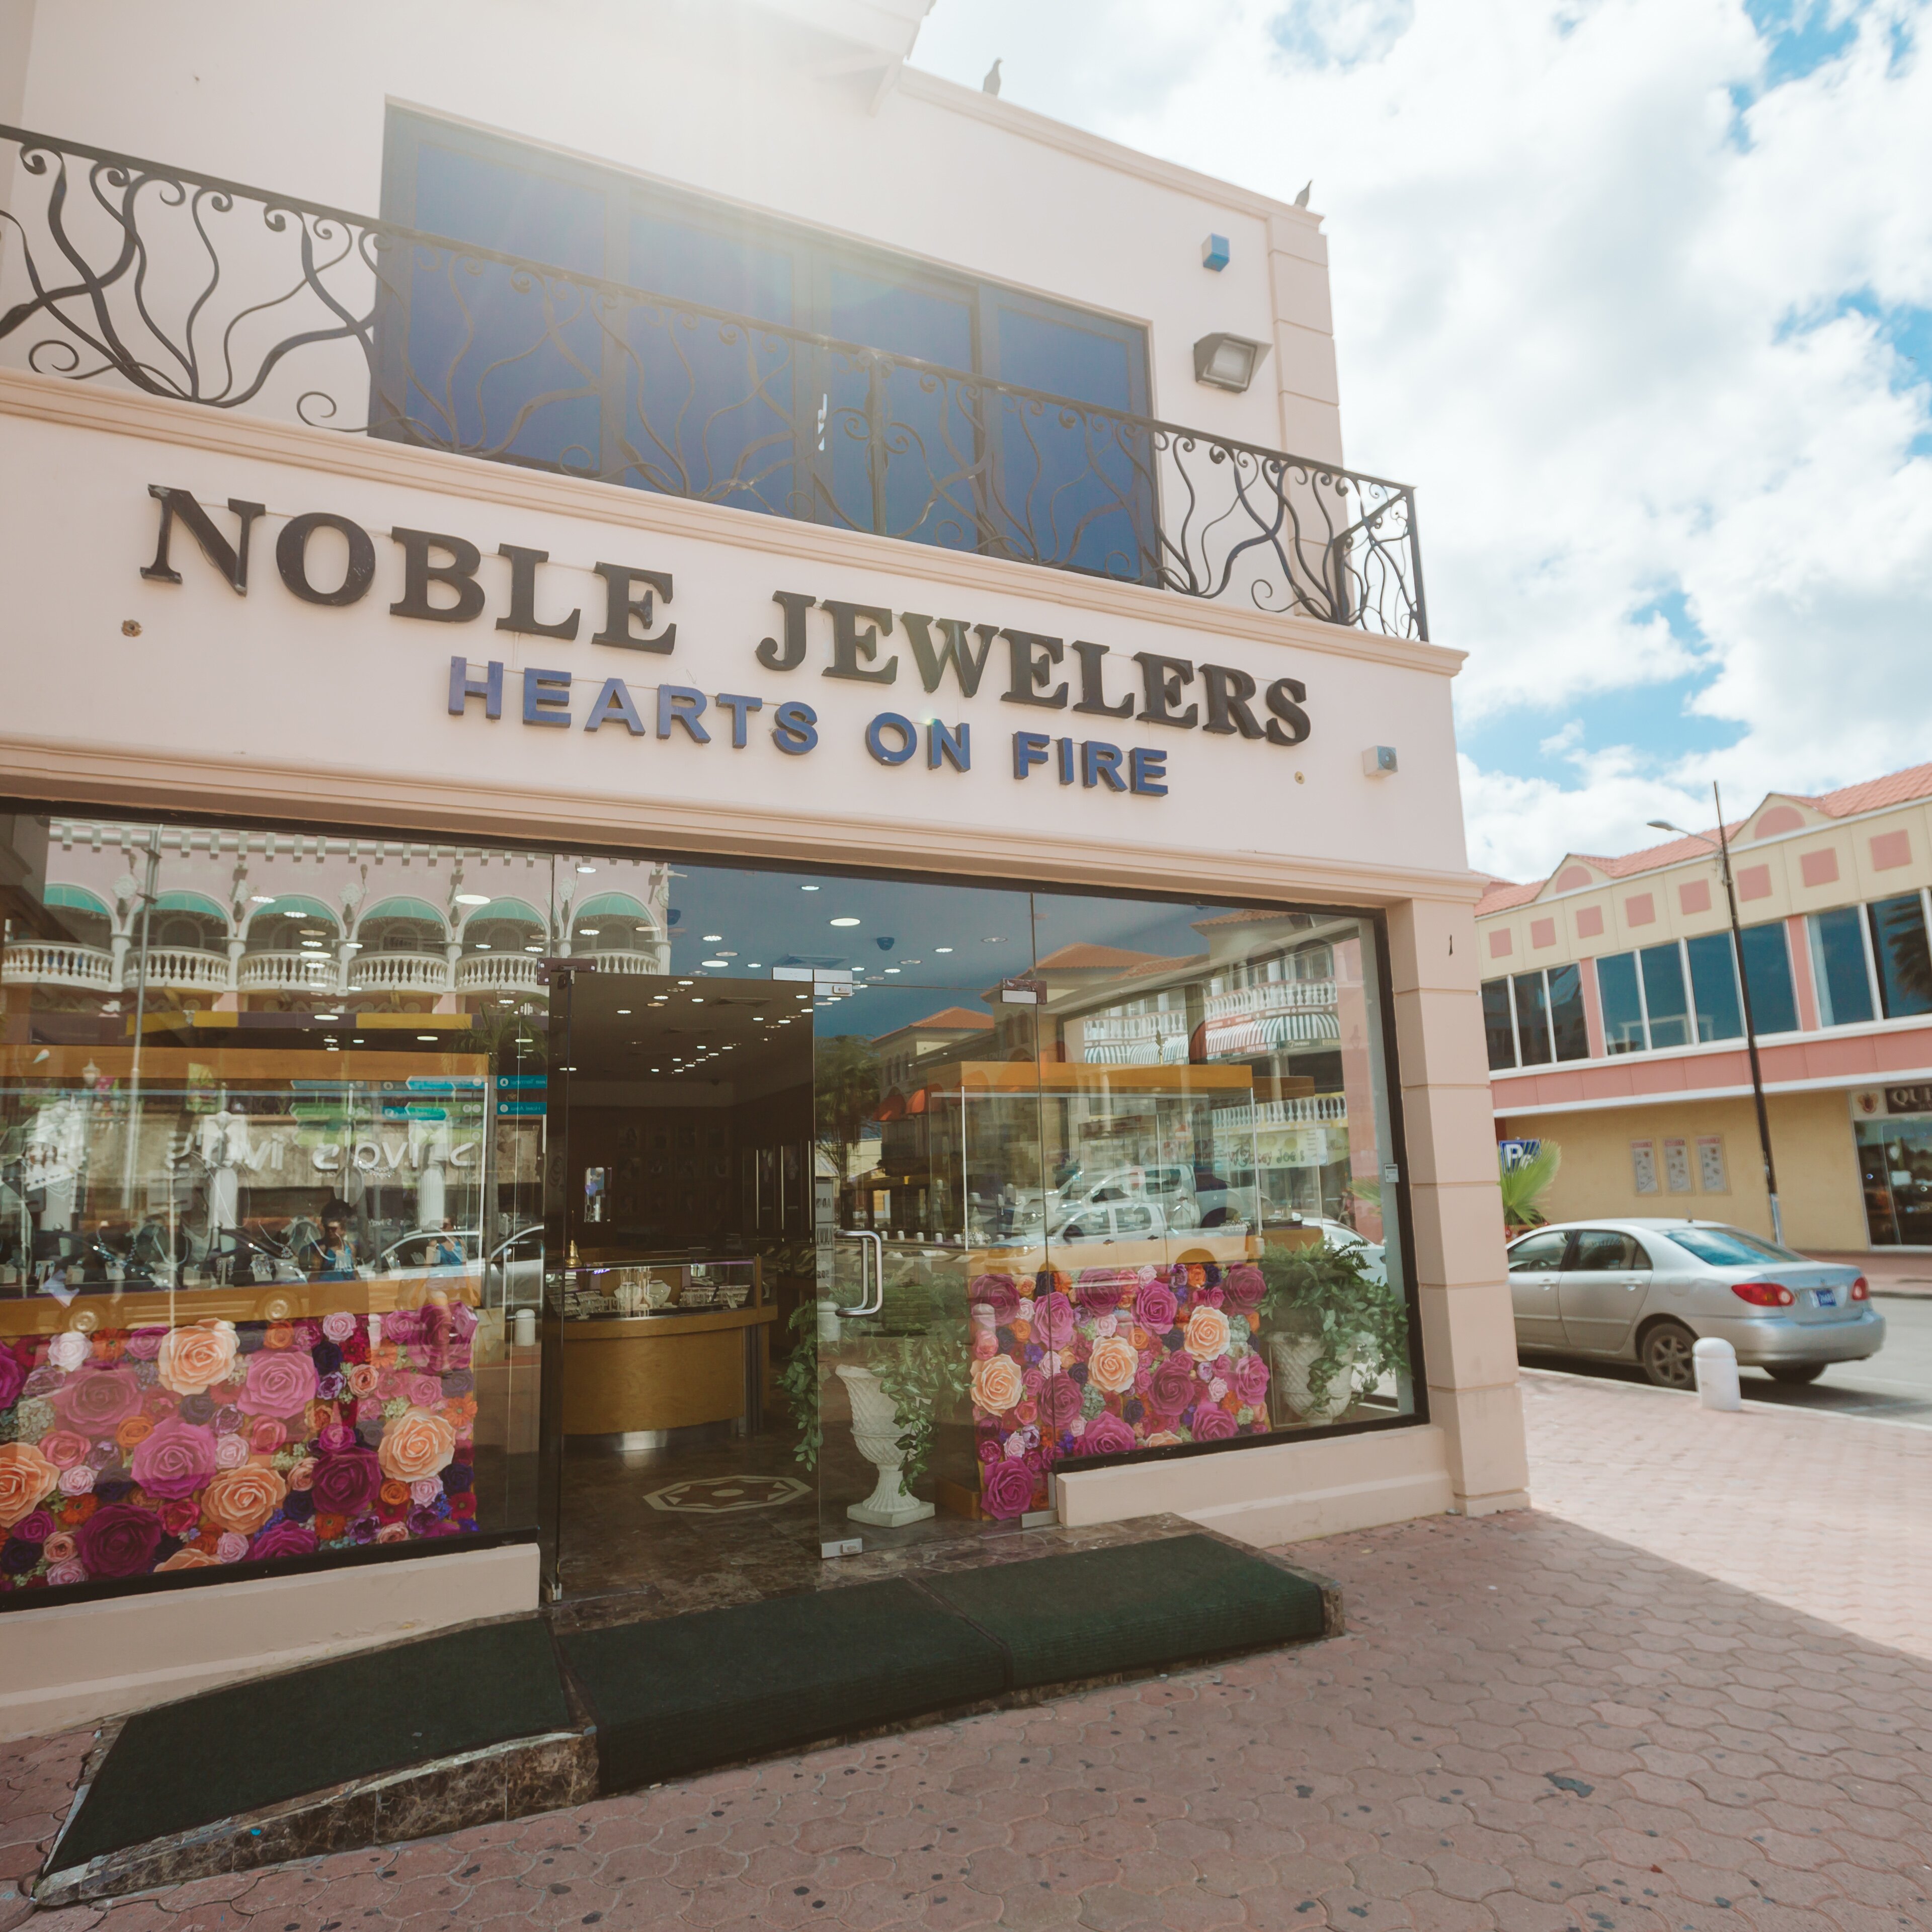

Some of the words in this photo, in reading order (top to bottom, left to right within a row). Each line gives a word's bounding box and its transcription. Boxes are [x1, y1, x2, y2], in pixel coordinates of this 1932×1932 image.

[140, 484, 677, 655] NOBLE
[754, 590, 1311, 747] JEWELERS
[448, 656, 818, 756] HEARTS
[865, 712, 971, 773] ON
[1013, 731, 1169, 797] FIRE
